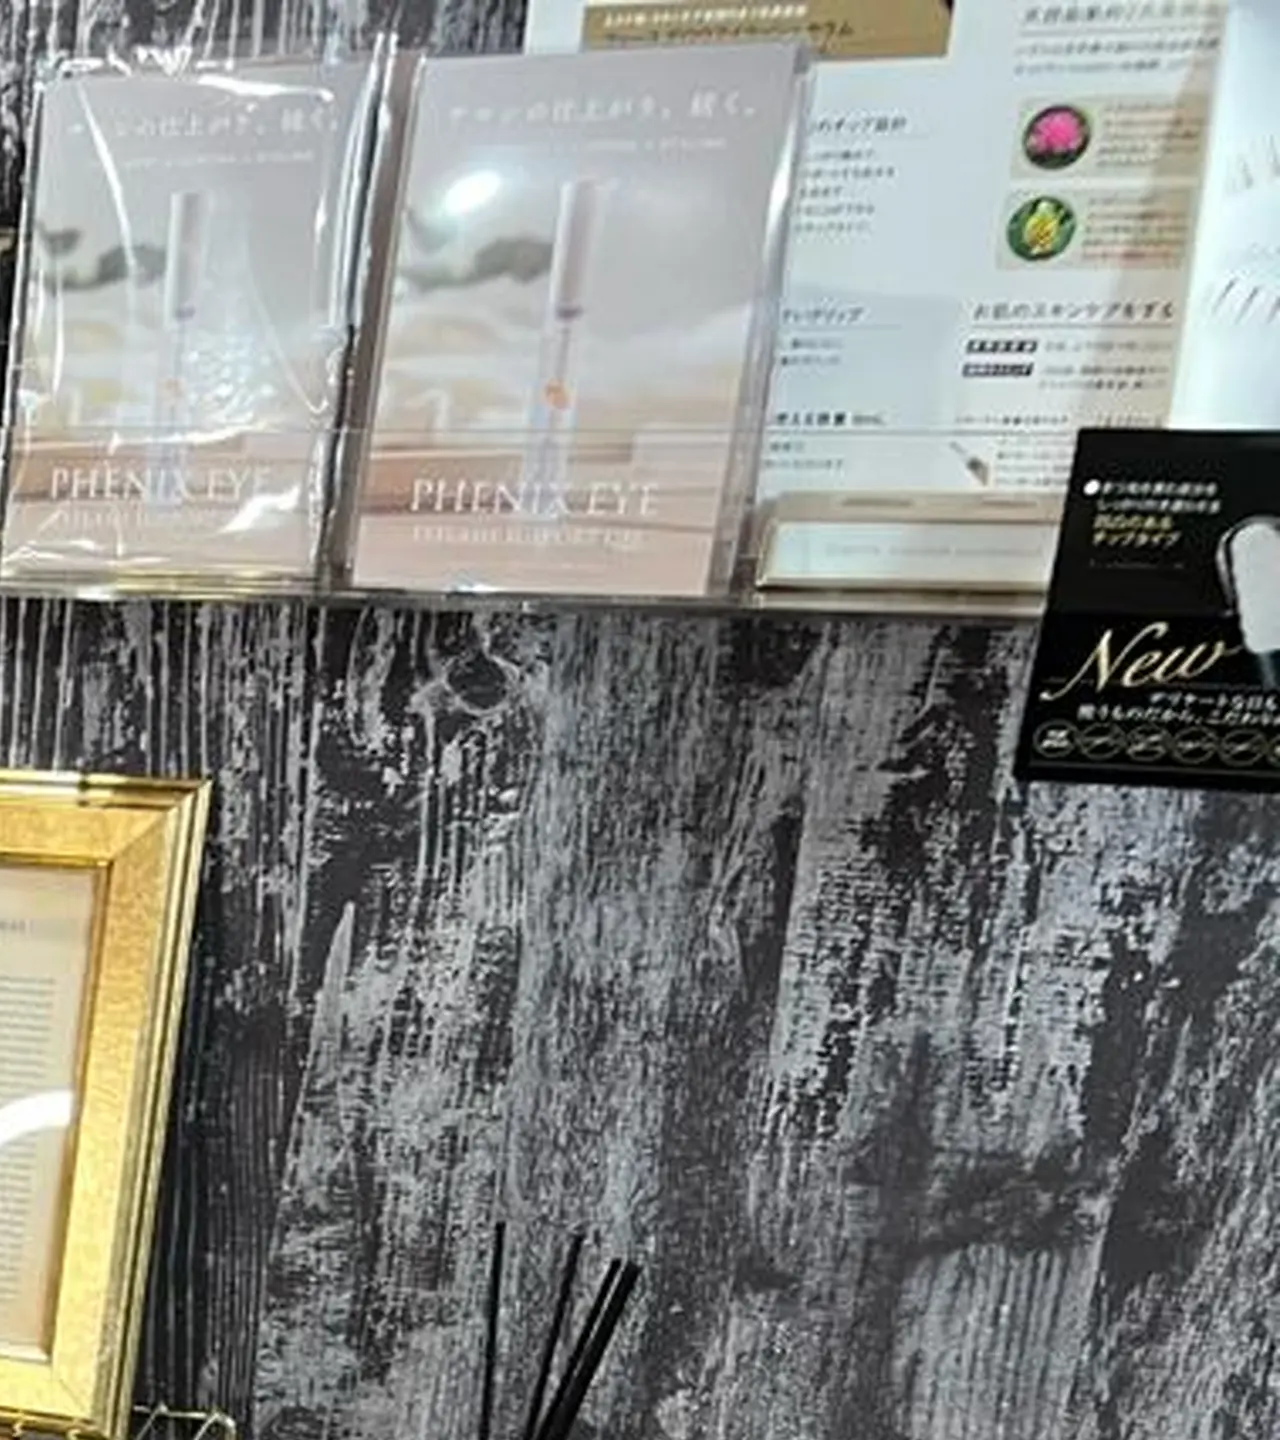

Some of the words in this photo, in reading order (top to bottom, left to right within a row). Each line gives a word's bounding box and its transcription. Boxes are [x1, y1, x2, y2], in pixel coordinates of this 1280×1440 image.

[49, 465, 199, 502] PHENIX
[409, 477, 573, 516] PHENIX
[586, 481, 661, 516] EYE
[1039, 621, 1243, 701] New
